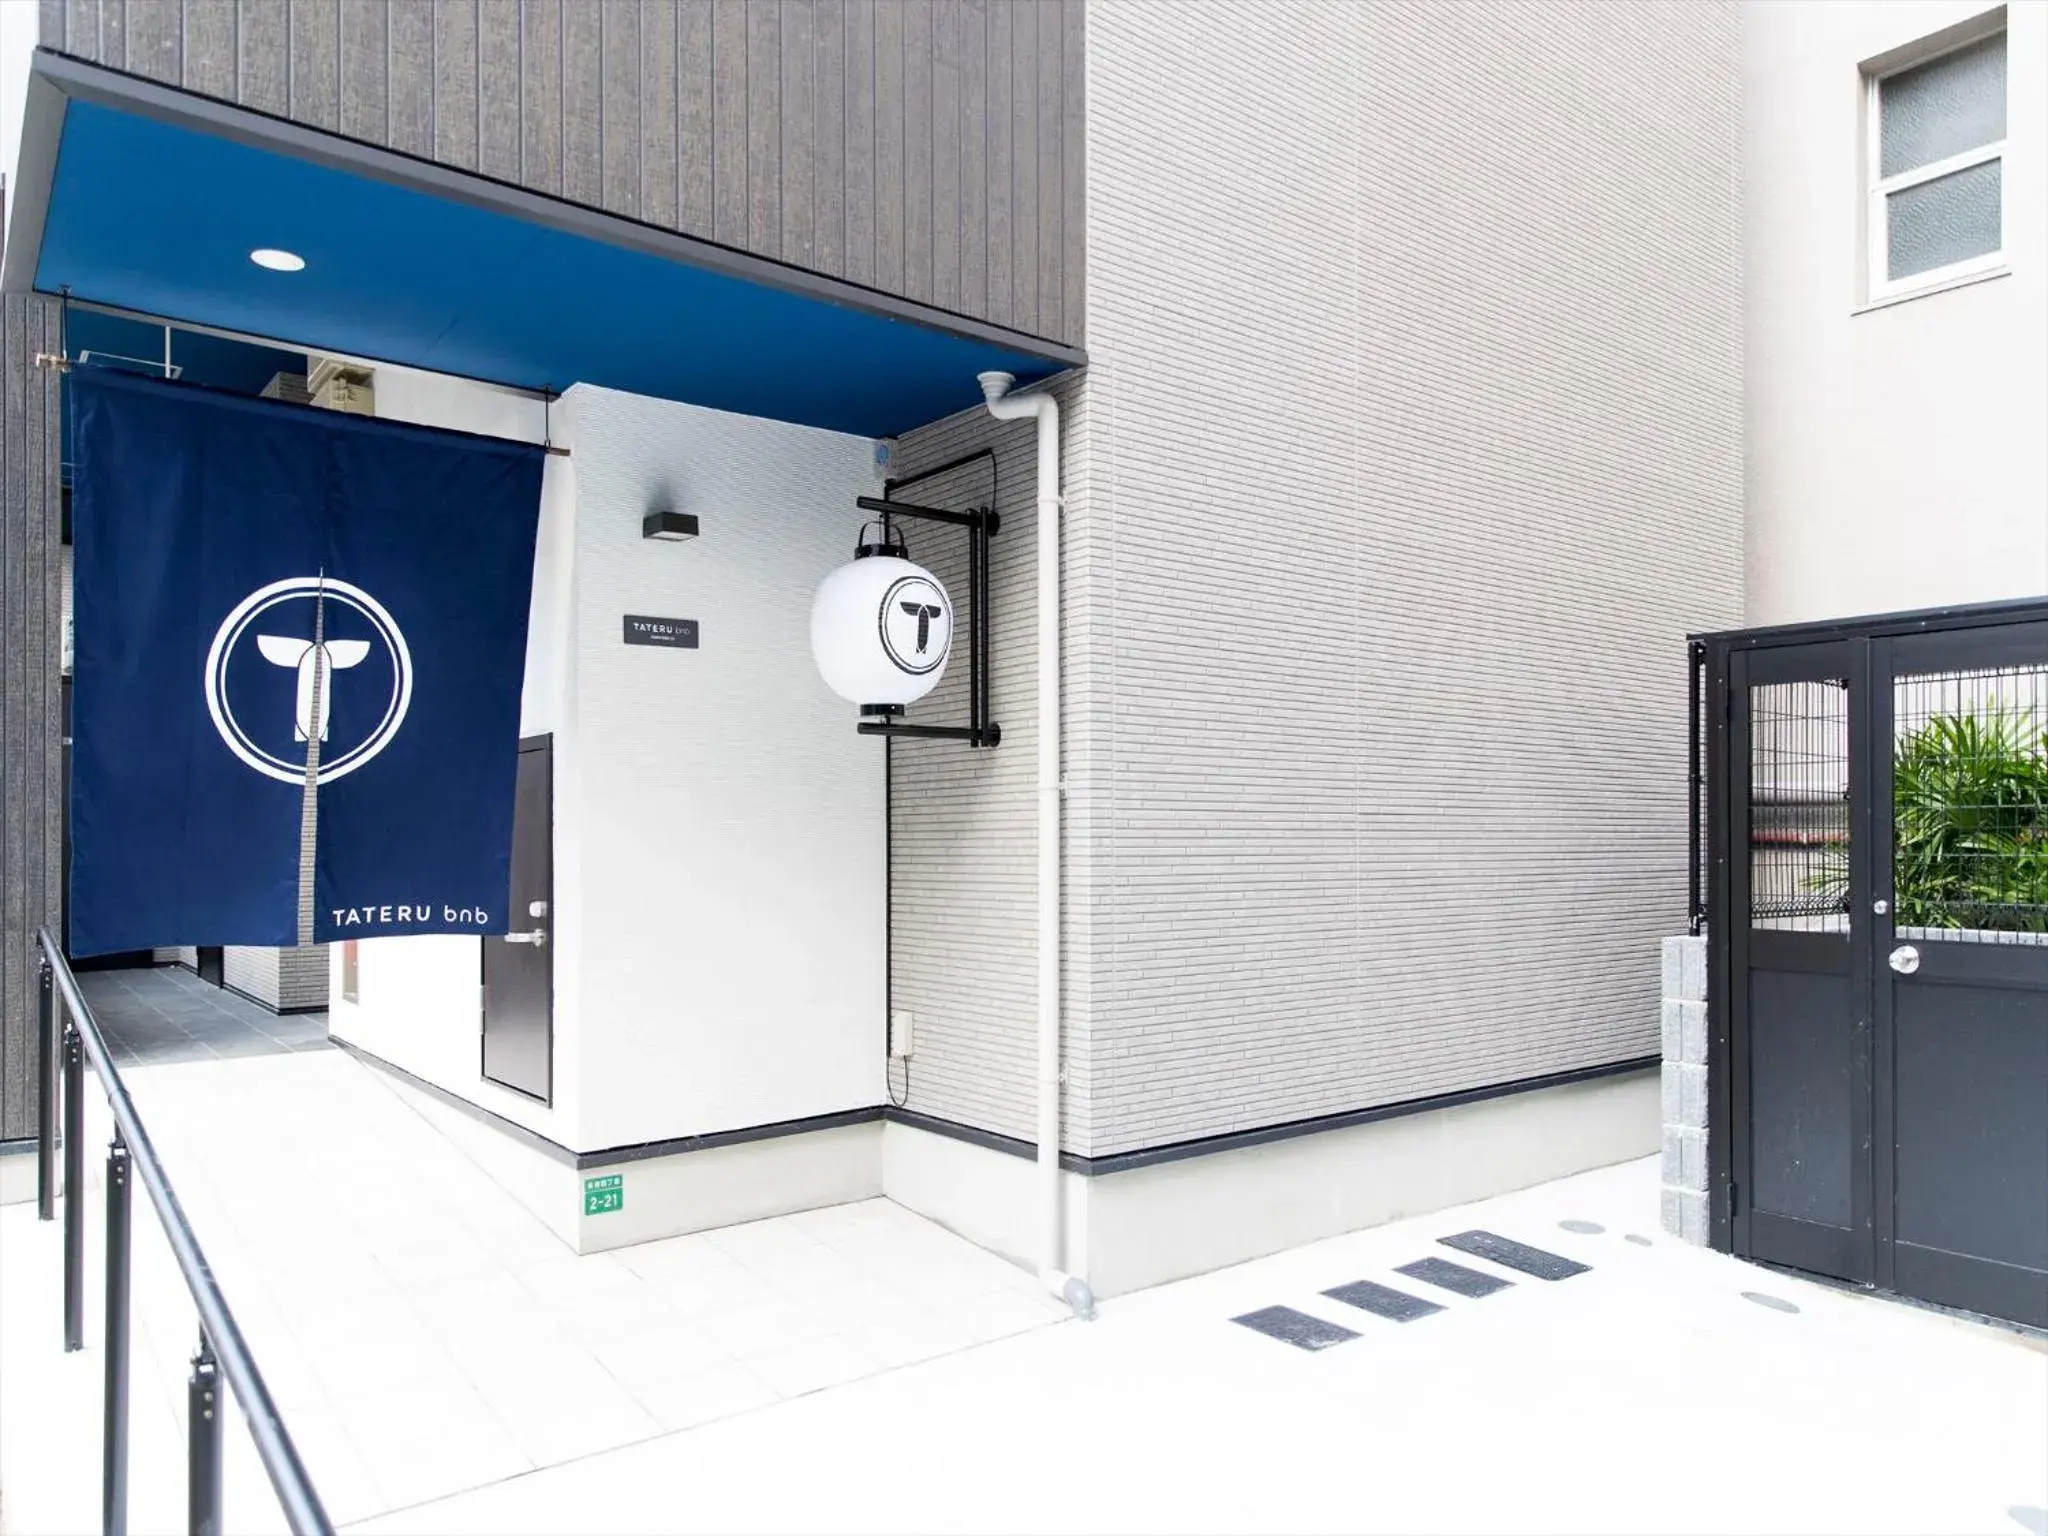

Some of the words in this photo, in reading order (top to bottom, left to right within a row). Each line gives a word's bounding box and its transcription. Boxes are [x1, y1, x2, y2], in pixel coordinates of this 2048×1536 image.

[633, 622, 673, 633] TATERU
[332, 905, 431, 926] TATERU
[444, 905, 488, 924] bnb
[590, 1193, 617, 1210] 2-21
